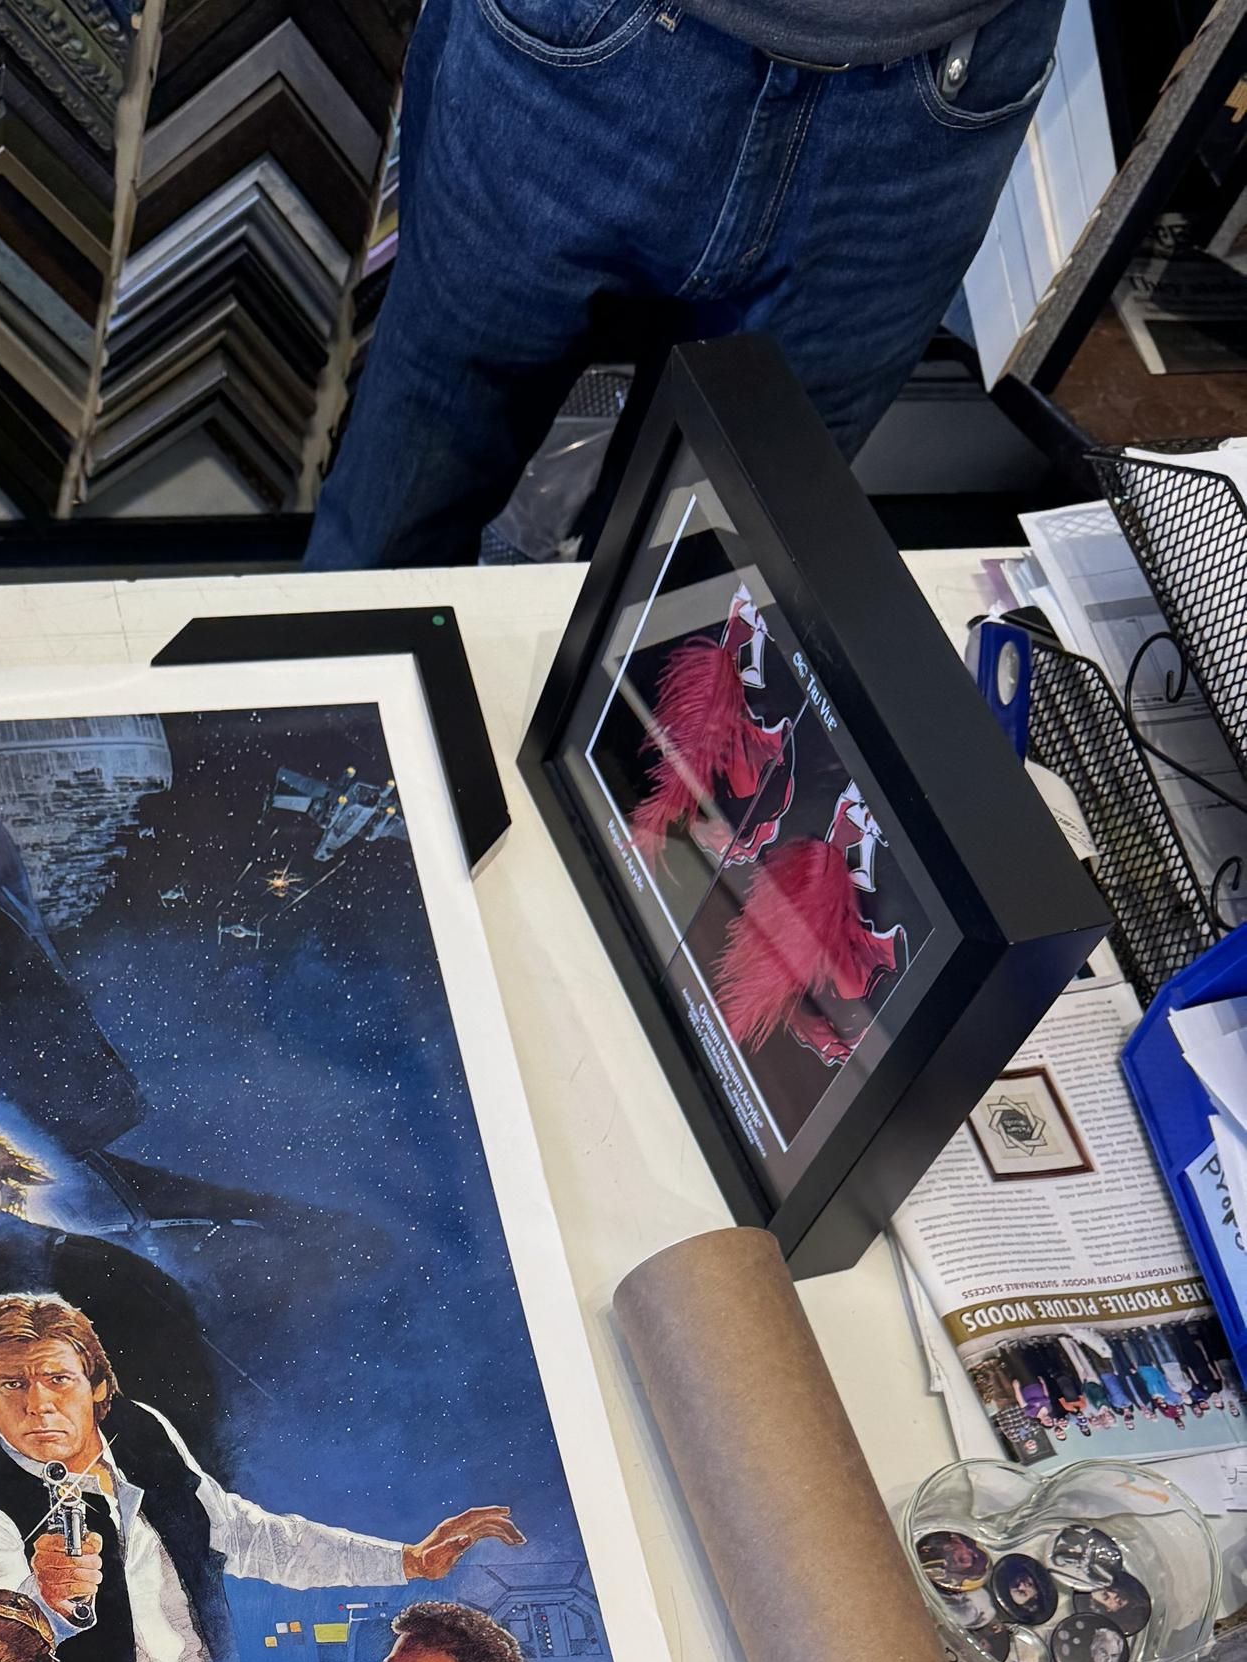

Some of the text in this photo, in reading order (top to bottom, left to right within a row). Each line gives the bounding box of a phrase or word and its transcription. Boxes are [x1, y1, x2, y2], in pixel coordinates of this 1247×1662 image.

[961, 1285, 1004, 1299] SUCCESS
[1102, 1287, 1173, 1314] PROFILE:
[961, 1304, 1036, 1333] WOODS
[1036, 1297, 1100, 1320] PICTURE
